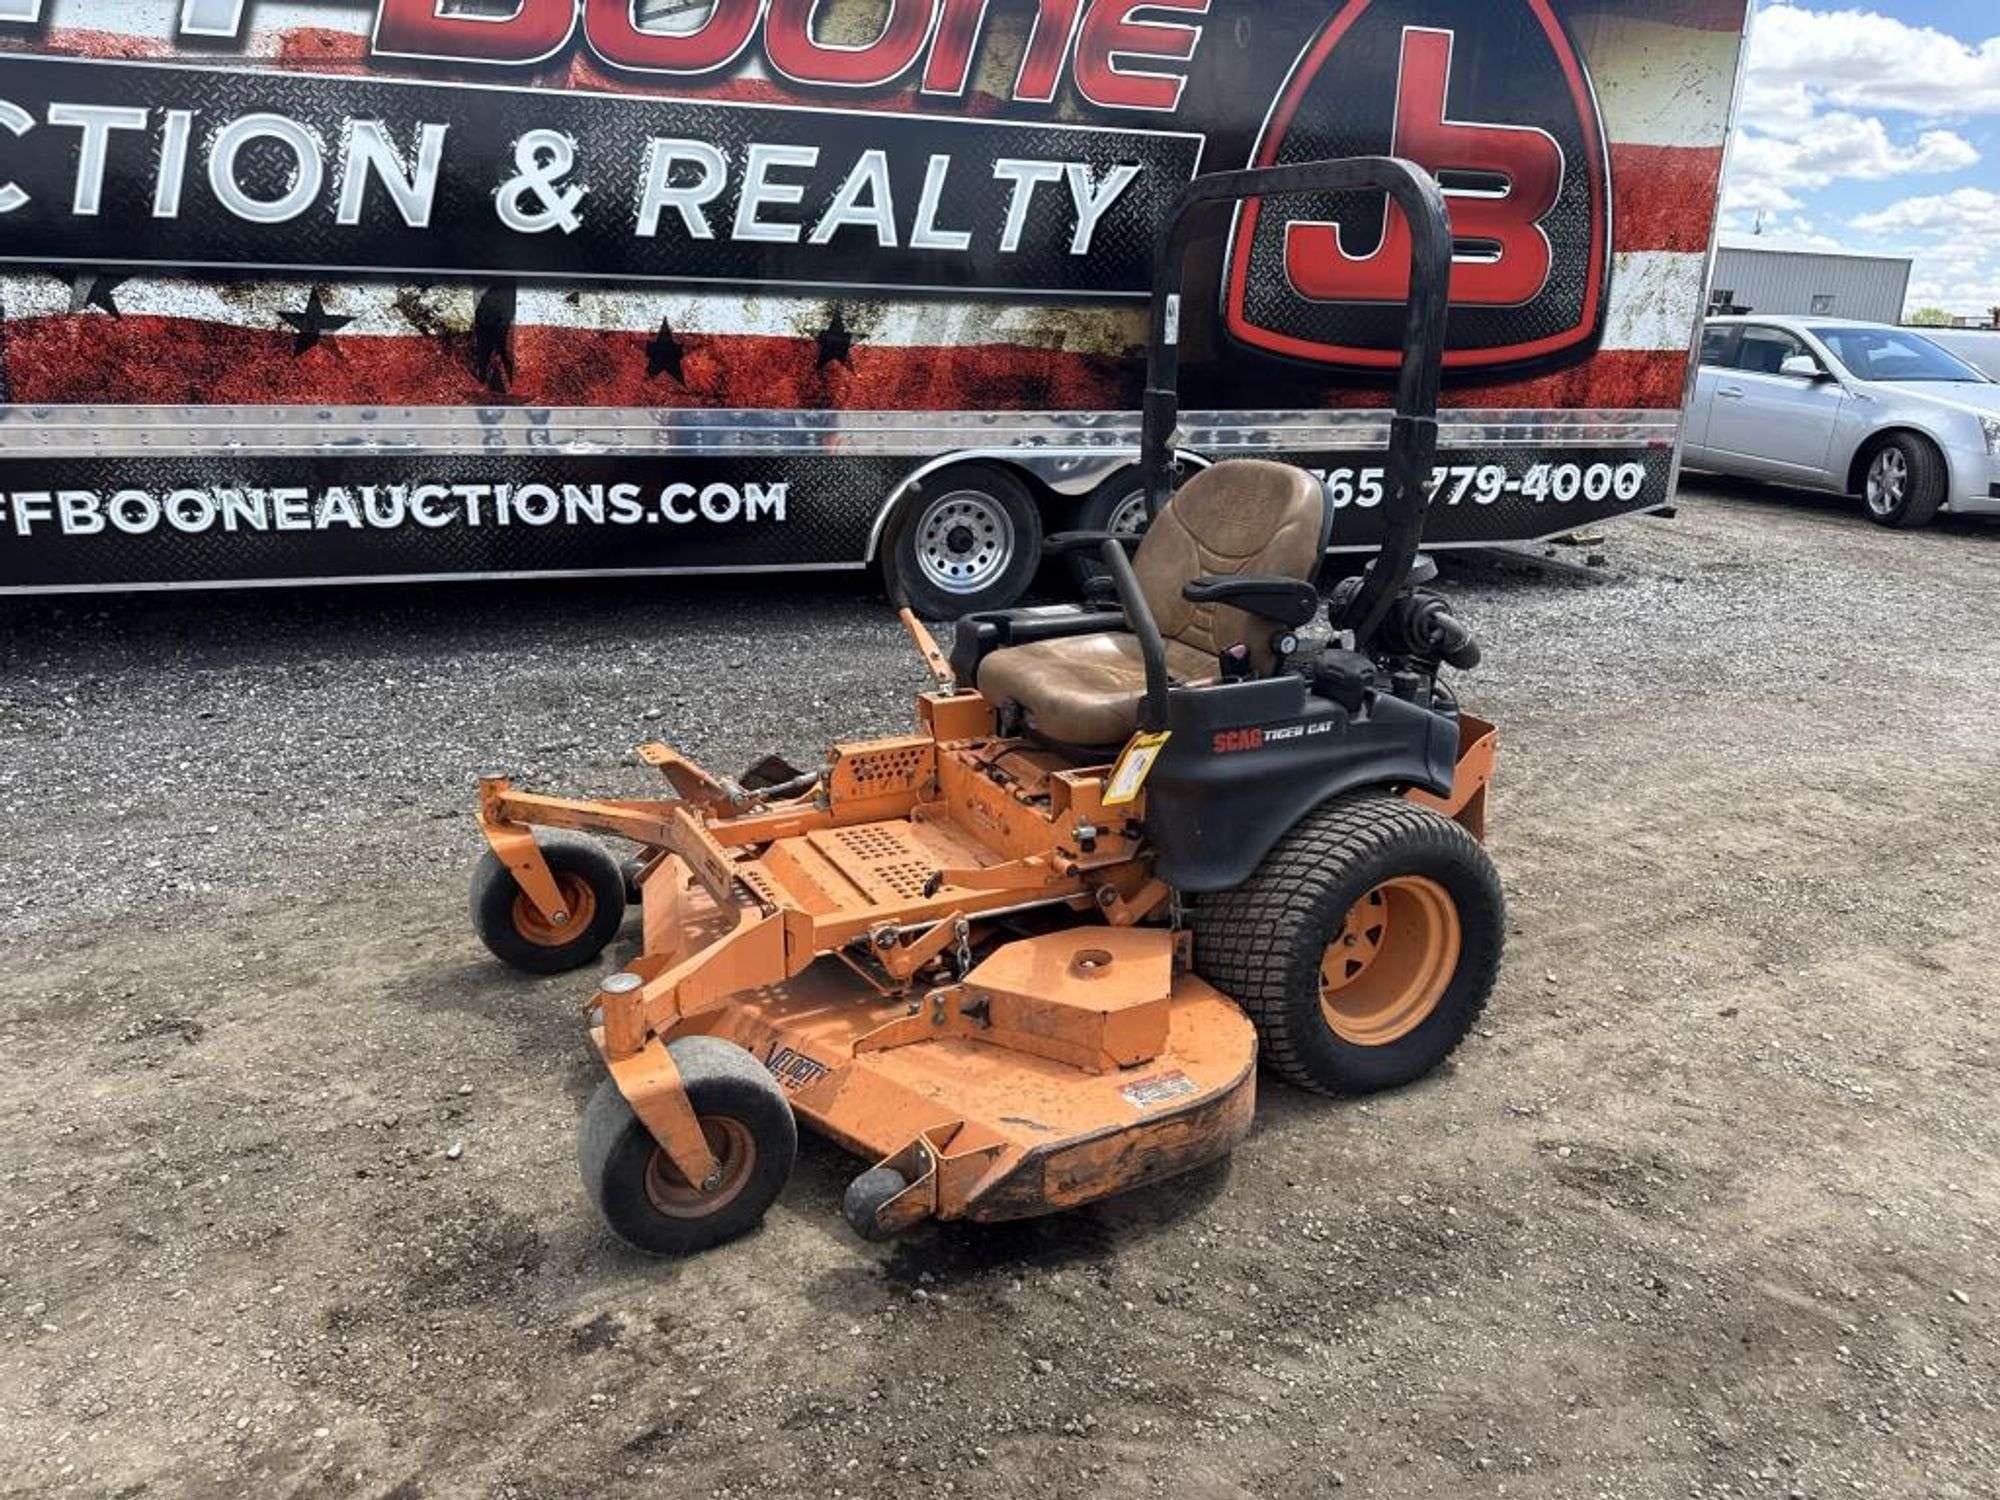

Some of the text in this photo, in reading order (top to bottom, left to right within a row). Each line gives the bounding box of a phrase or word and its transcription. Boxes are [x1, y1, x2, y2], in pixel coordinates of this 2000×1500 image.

[495, 128, 588, 234] &
[634, 137, 1142, 256] REALTY
[0, 482, 790, 536] FBOONEAUCTIONS.COM
[1307, 468, 1385, 508] 65
[1212, 720, 1335, 753] SCAG TIGER CAT
